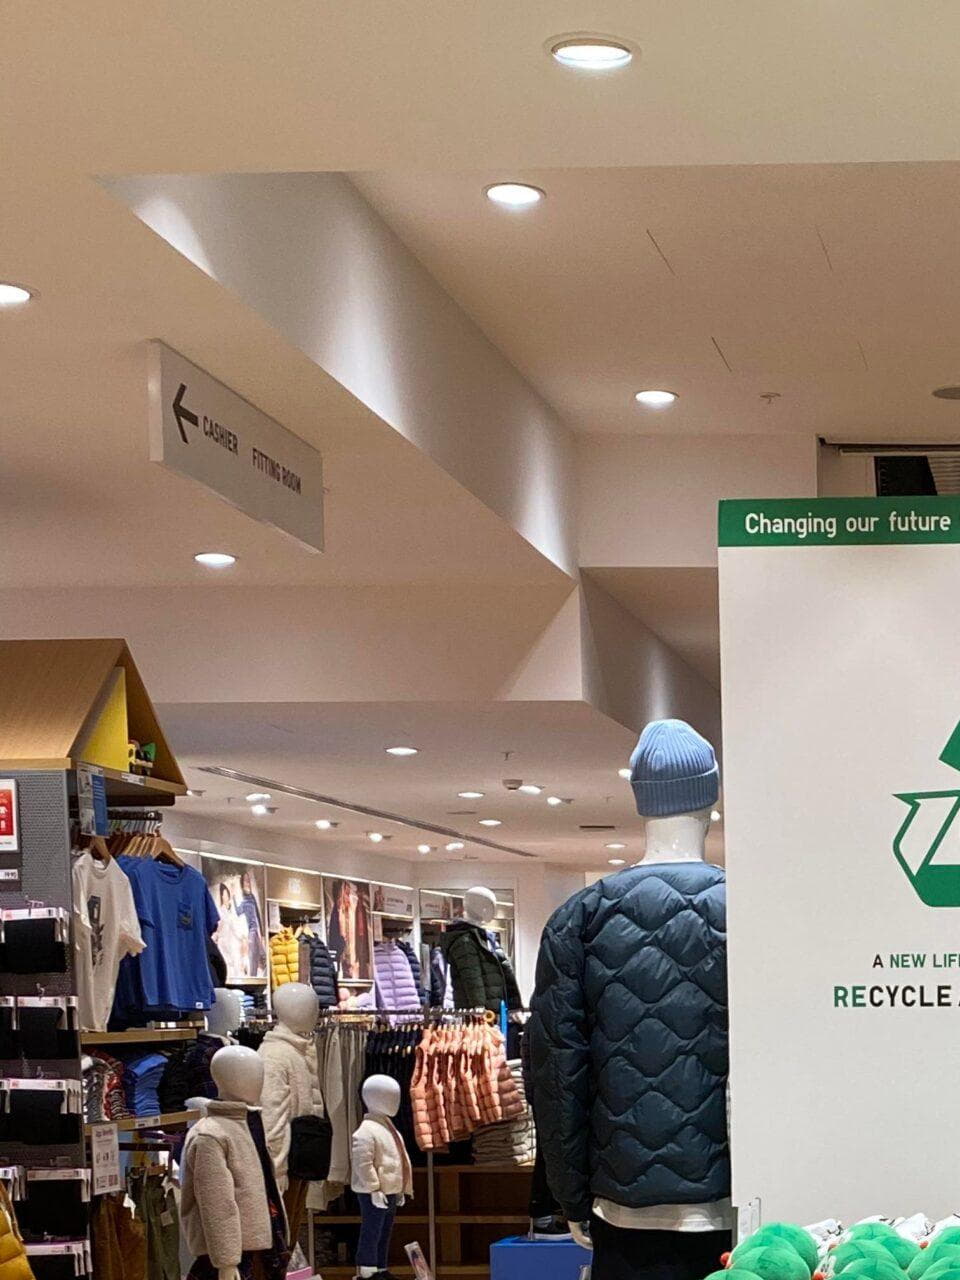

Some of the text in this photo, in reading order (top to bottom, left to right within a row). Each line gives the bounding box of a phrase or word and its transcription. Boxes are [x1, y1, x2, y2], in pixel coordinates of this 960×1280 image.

[203, 415, 239, 456] CASHIER
[252, 447, 302, 495] FITTING ROOM
[745, 513, 837, 538] Changing
[846, 516, 879, 533] our
[889, 511, 951, 532] future
[872, 953, 884, 968] A
[889, 953, 926, 968] NEW
[834, 985, 951, 1008] RECYCLE
